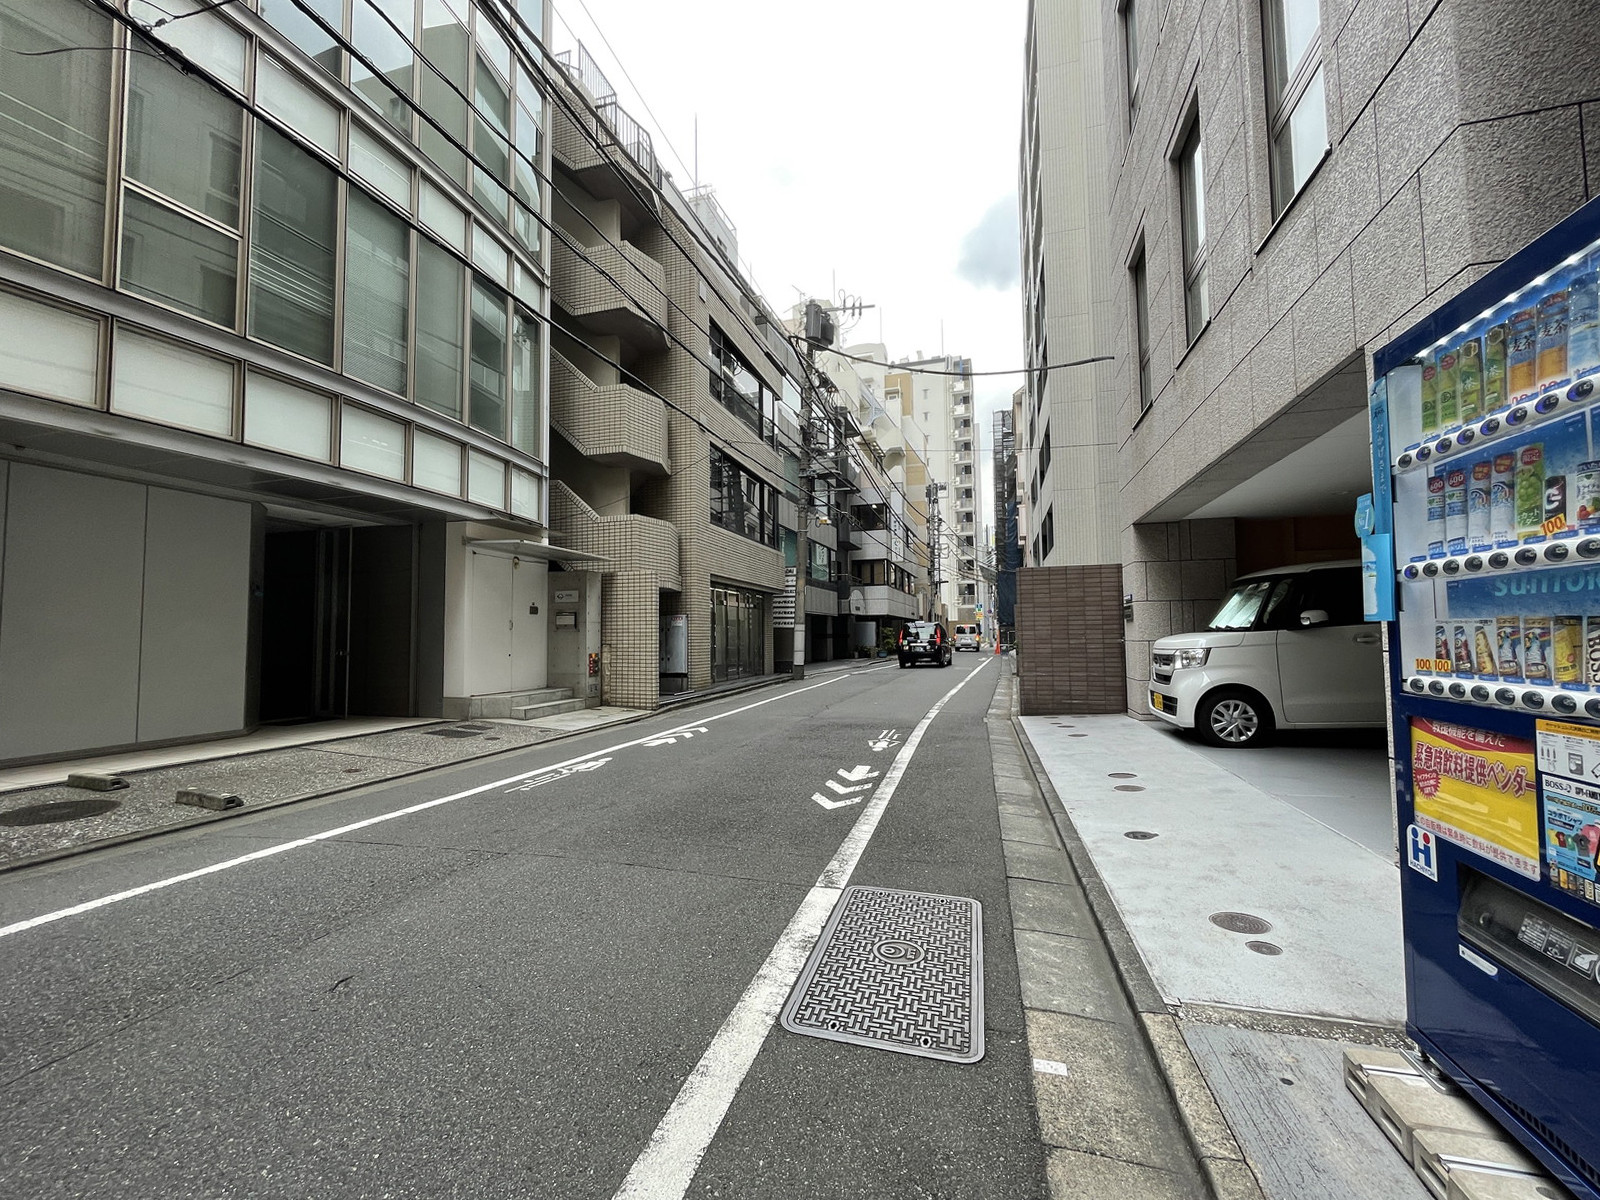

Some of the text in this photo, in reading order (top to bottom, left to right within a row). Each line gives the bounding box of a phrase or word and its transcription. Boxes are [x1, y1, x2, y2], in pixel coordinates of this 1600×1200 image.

[1414, 742, 1537, 798] 緊急時飲料提供ベンダー
[1545, 779, 1564, 791] BOSS
